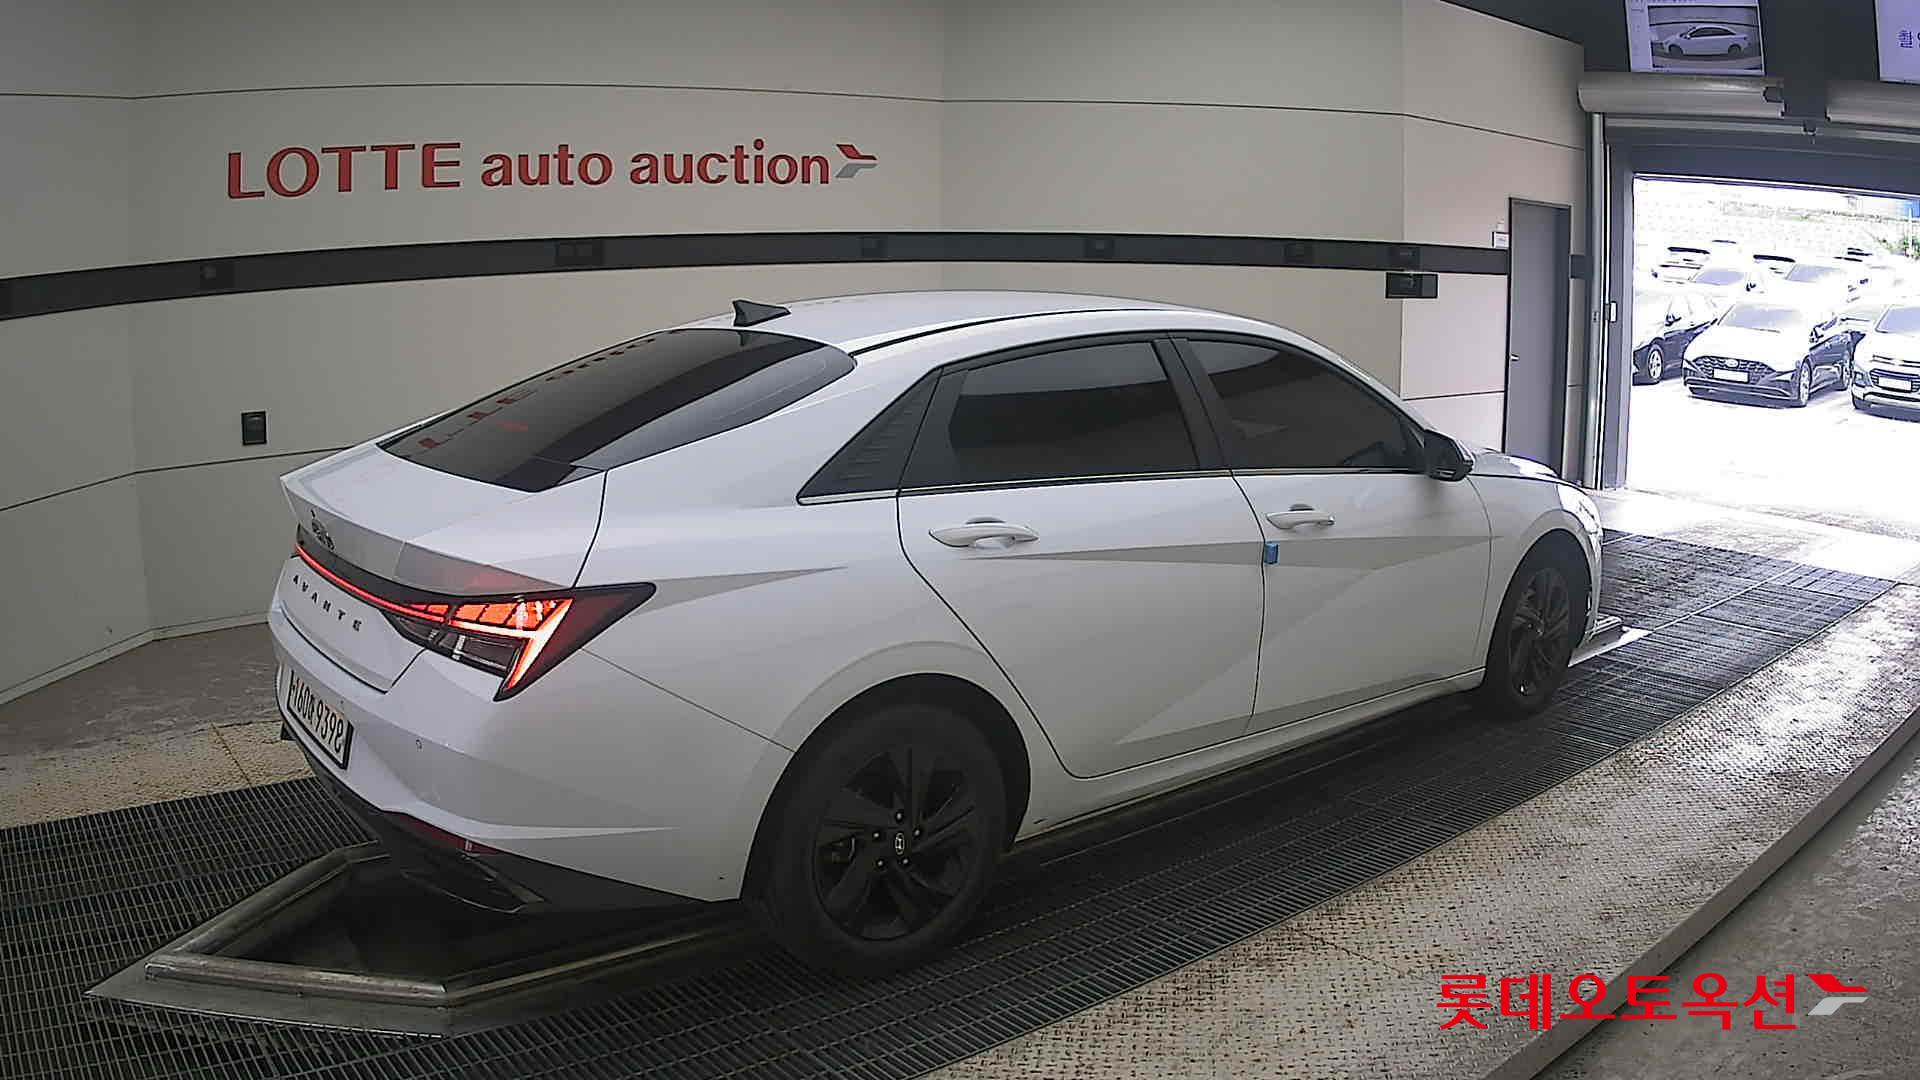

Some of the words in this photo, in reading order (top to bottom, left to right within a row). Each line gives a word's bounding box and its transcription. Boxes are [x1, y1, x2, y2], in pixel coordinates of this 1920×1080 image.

[227, 142, 461, 199] LOTTE
[480, 144, 614, 187] auto
[629, 138, 830, 185] auction
[292, 574, 363, 633] AVANTE
